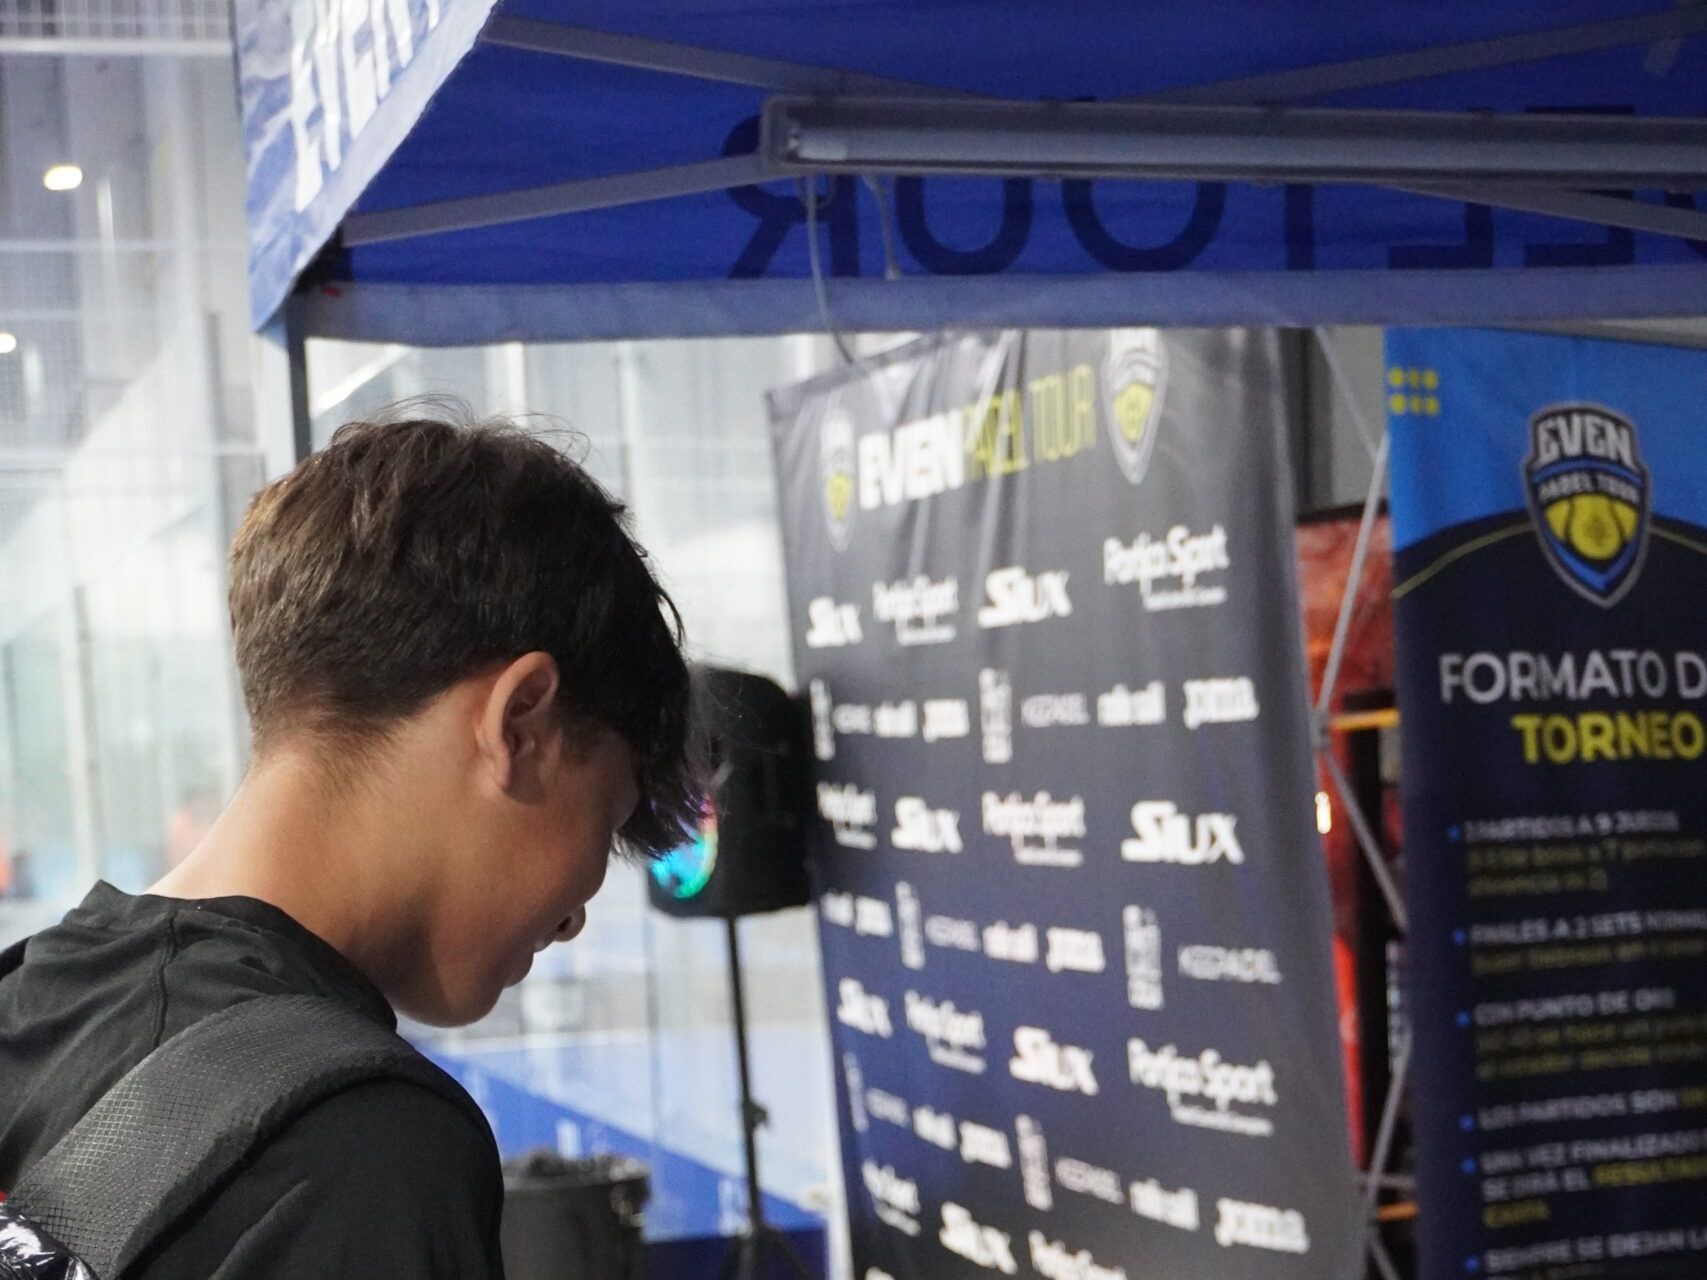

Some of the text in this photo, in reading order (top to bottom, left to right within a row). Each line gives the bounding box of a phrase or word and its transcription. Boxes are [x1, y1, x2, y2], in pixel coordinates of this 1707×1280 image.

[1535, 413, 1635, 469] EVEN
[1438, 649, 1667, 705] FORMATO
[1511, 711, 1704, 765] TORNEO
